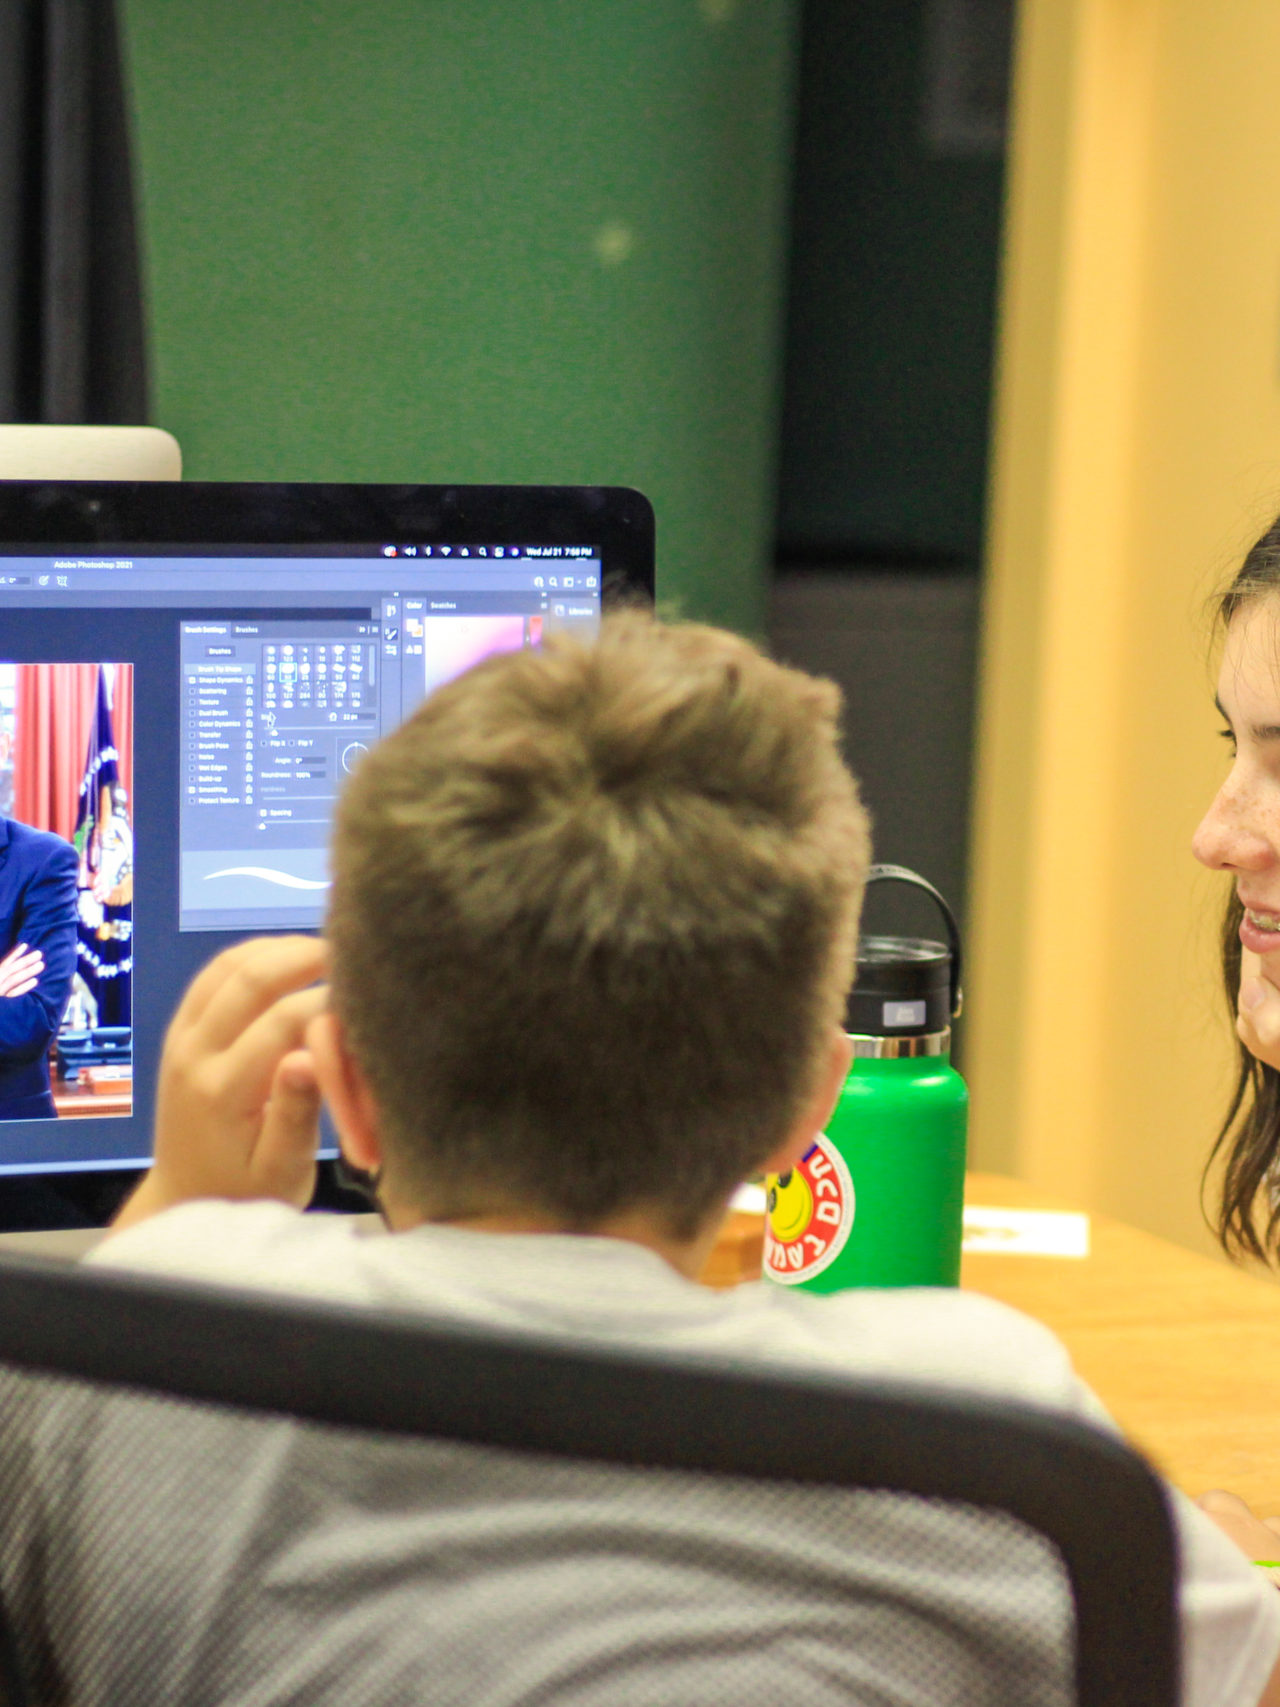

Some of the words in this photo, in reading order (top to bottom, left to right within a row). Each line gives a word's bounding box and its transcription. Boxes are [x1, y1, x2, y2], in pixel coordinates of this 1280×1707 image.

[526, 547, 541, 556] Wed
[542, 547, 552, 556] Jul
[553, 547, 562, 556] 21
[581, 547, 592, 556] PM
[54, 561, 77, 569] Adobe
[78, 561, 114, 569] Photoshop
[115, 561, 133, 569] 2021
[203, 626, 226, 634] Settings
[214, 720, 241, 728] Dynamics
[198, 786, 228, 794] Smoothing
[809, 1155, 841, 1226] חכם
[766, 1233, 827, 1269] בשמ
